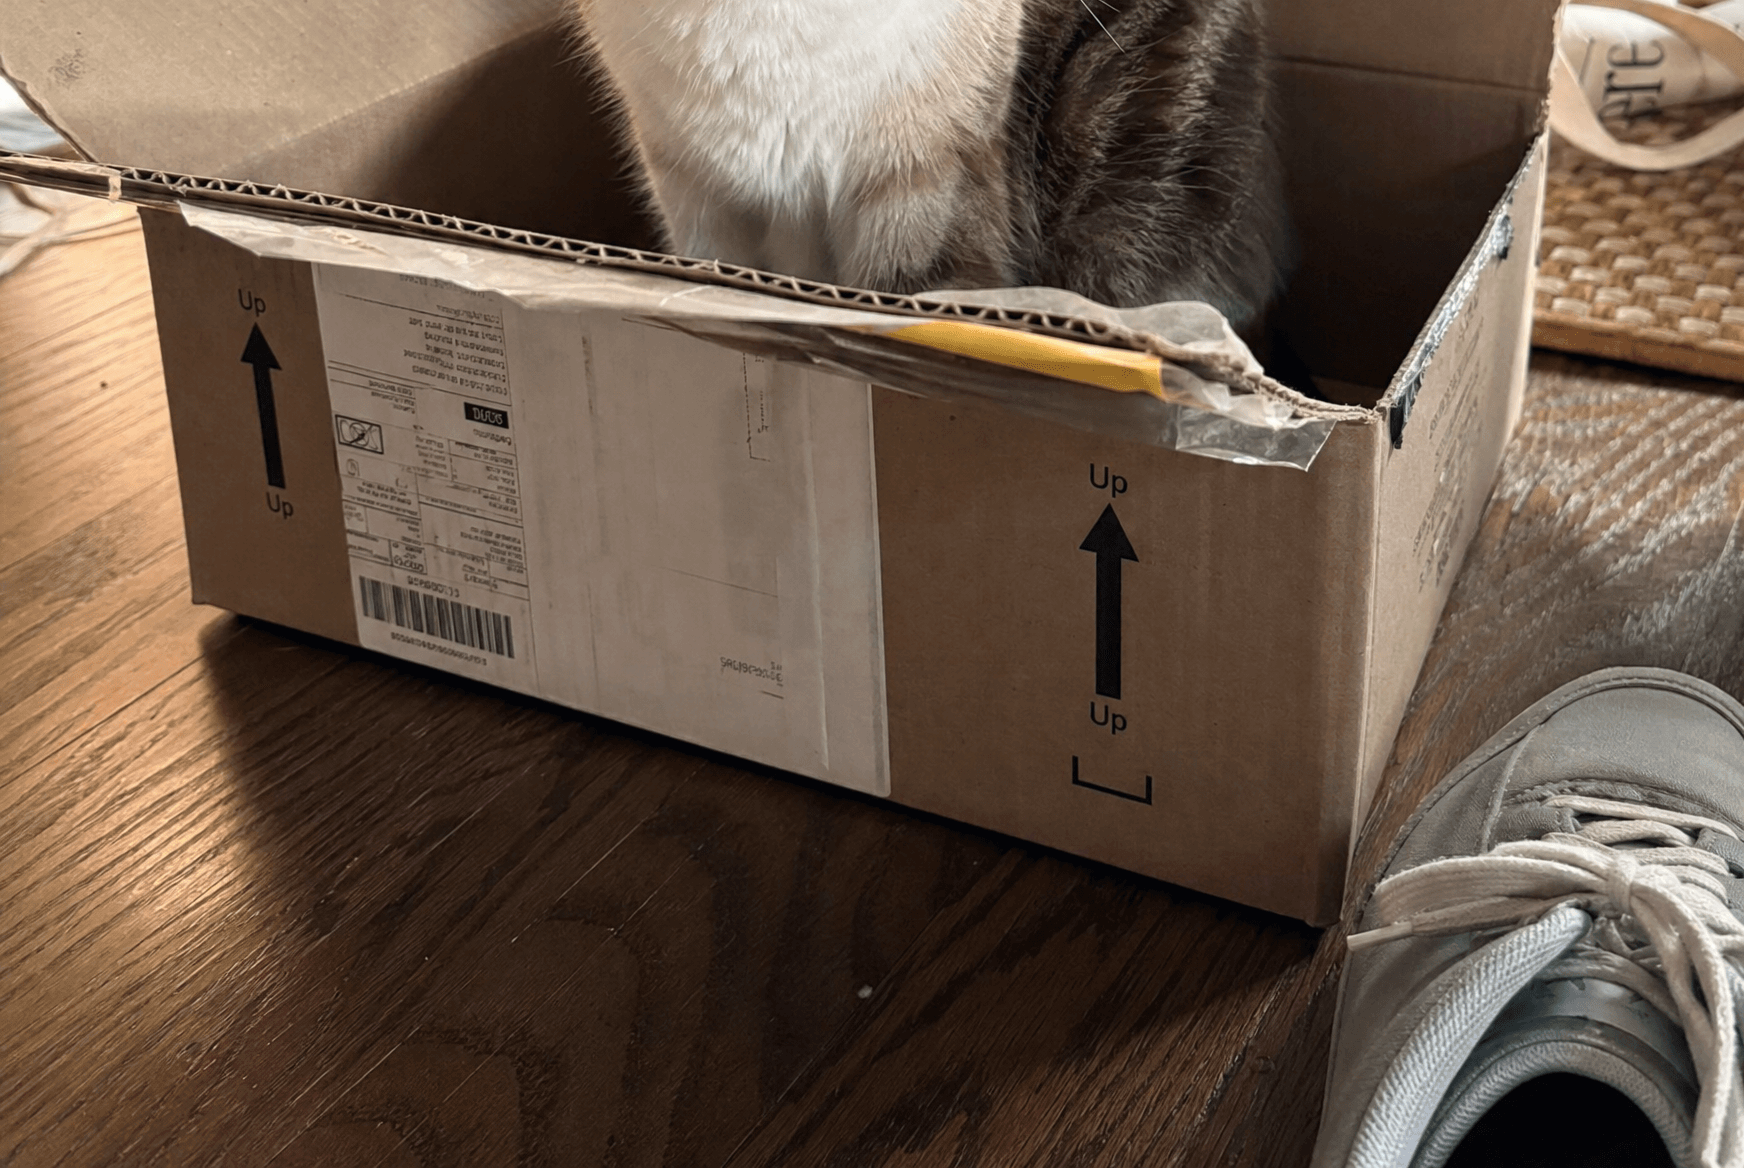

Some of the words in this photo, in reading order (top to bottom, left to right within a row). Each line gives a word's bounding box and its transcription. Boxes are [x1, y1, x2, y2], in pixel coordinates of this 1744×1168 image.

[238, 288, 267, 317] Up
[1090, 463, 1128, 499] Up
[266, 492, 294, 520] Up
[1090, 701, 1128, 735] Up
